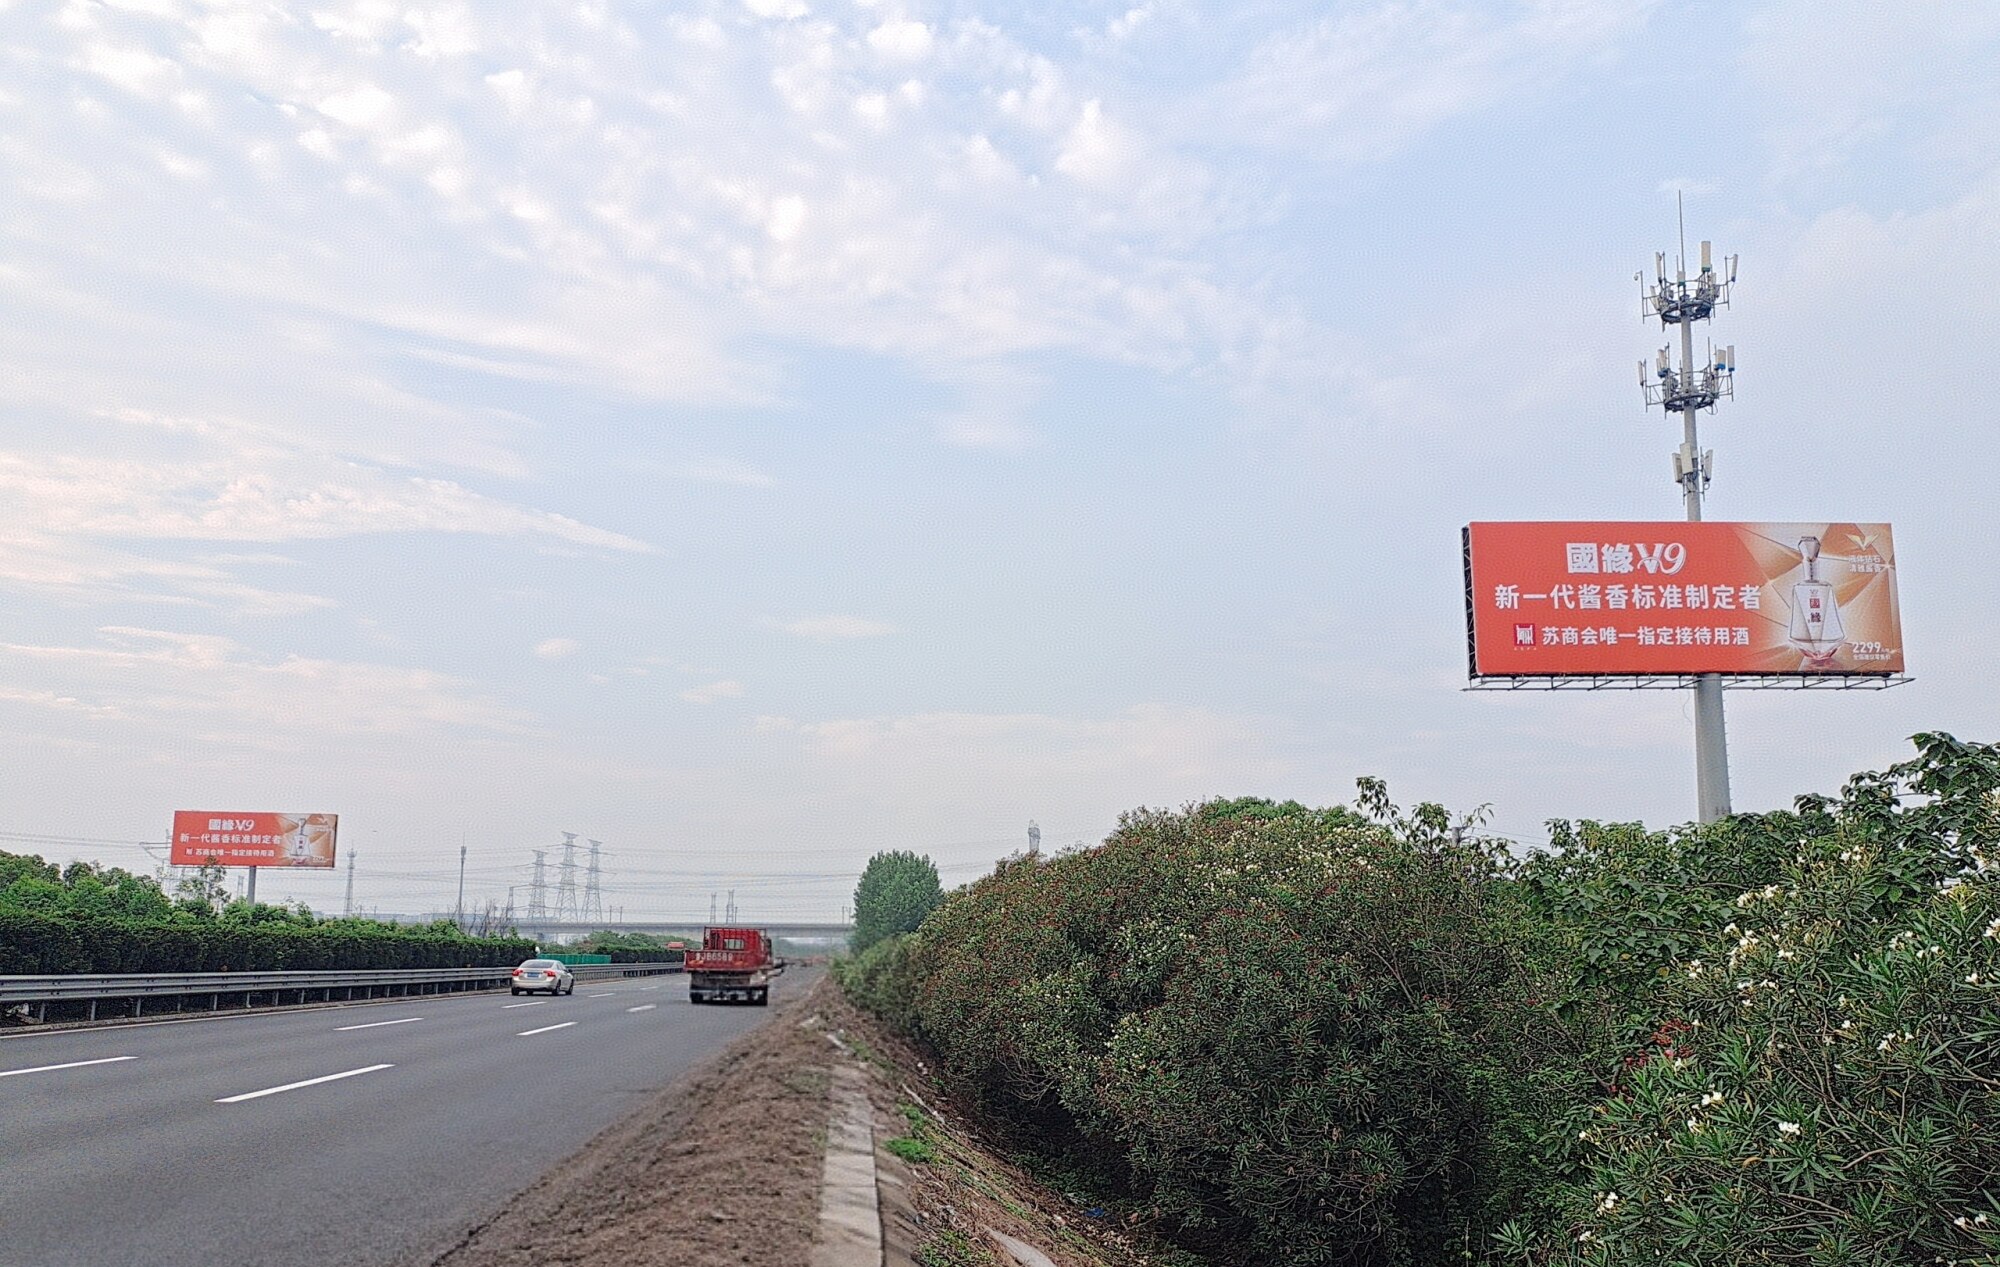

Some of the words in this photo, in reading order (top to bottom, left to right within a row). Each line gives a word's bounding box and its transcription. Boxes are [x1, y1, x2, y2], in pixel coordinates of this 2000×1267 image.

[1495, 584, 1762, 610] 新一代酱香标准制定者
[1541, 626, 1750, 645] 苏商会唯一指定接待用酒
[180, 832, 282, 844] 新一代酱香标准制定者
